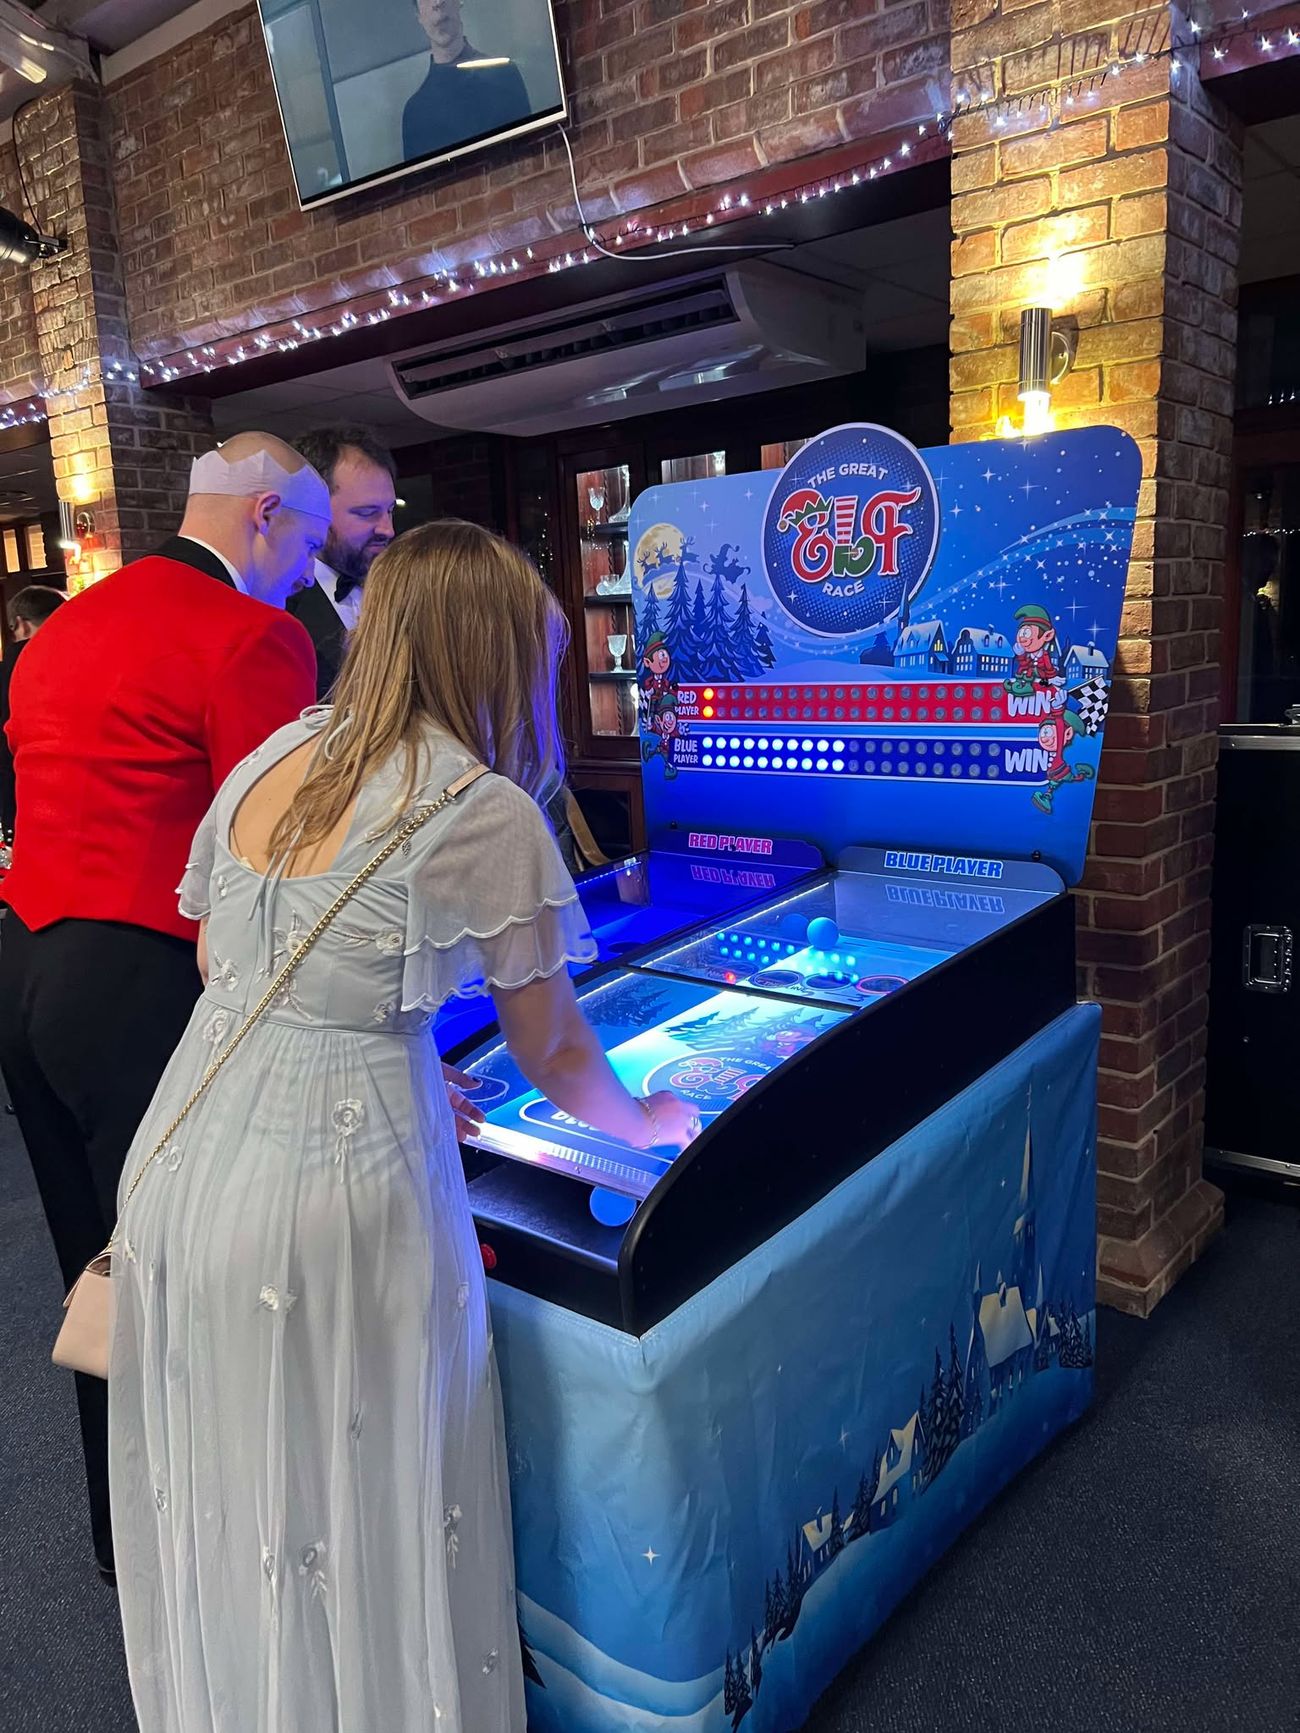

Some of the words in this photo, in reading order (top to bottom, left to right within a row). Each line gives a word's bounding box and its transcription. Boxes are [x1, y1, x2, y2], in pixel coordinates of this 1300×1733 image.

[807, 467, 836, 489] THE
[838, 463, 889, 480] GREAT
[777, 487, 921, 583] ELF
[822, 580, 865, 597] RACE
[677, 690, 697, 704] RED
[1007, 690, 1052, 717] WIN
[674, 706, 699, 716] PLAYER
[674, 738, 698, 753] BLUE
[673, 753, 699, 764] PLAYER
[1005, 748, 1049, 773] WIN
[688, 832, 717, 849] RED
[884, 850, 932, 871] BLUE
[931, 854, 1003, 879] PLAYER
[744, 1059, 772, 1071] GREA
[681, 1089, 713, 1100] RACE
